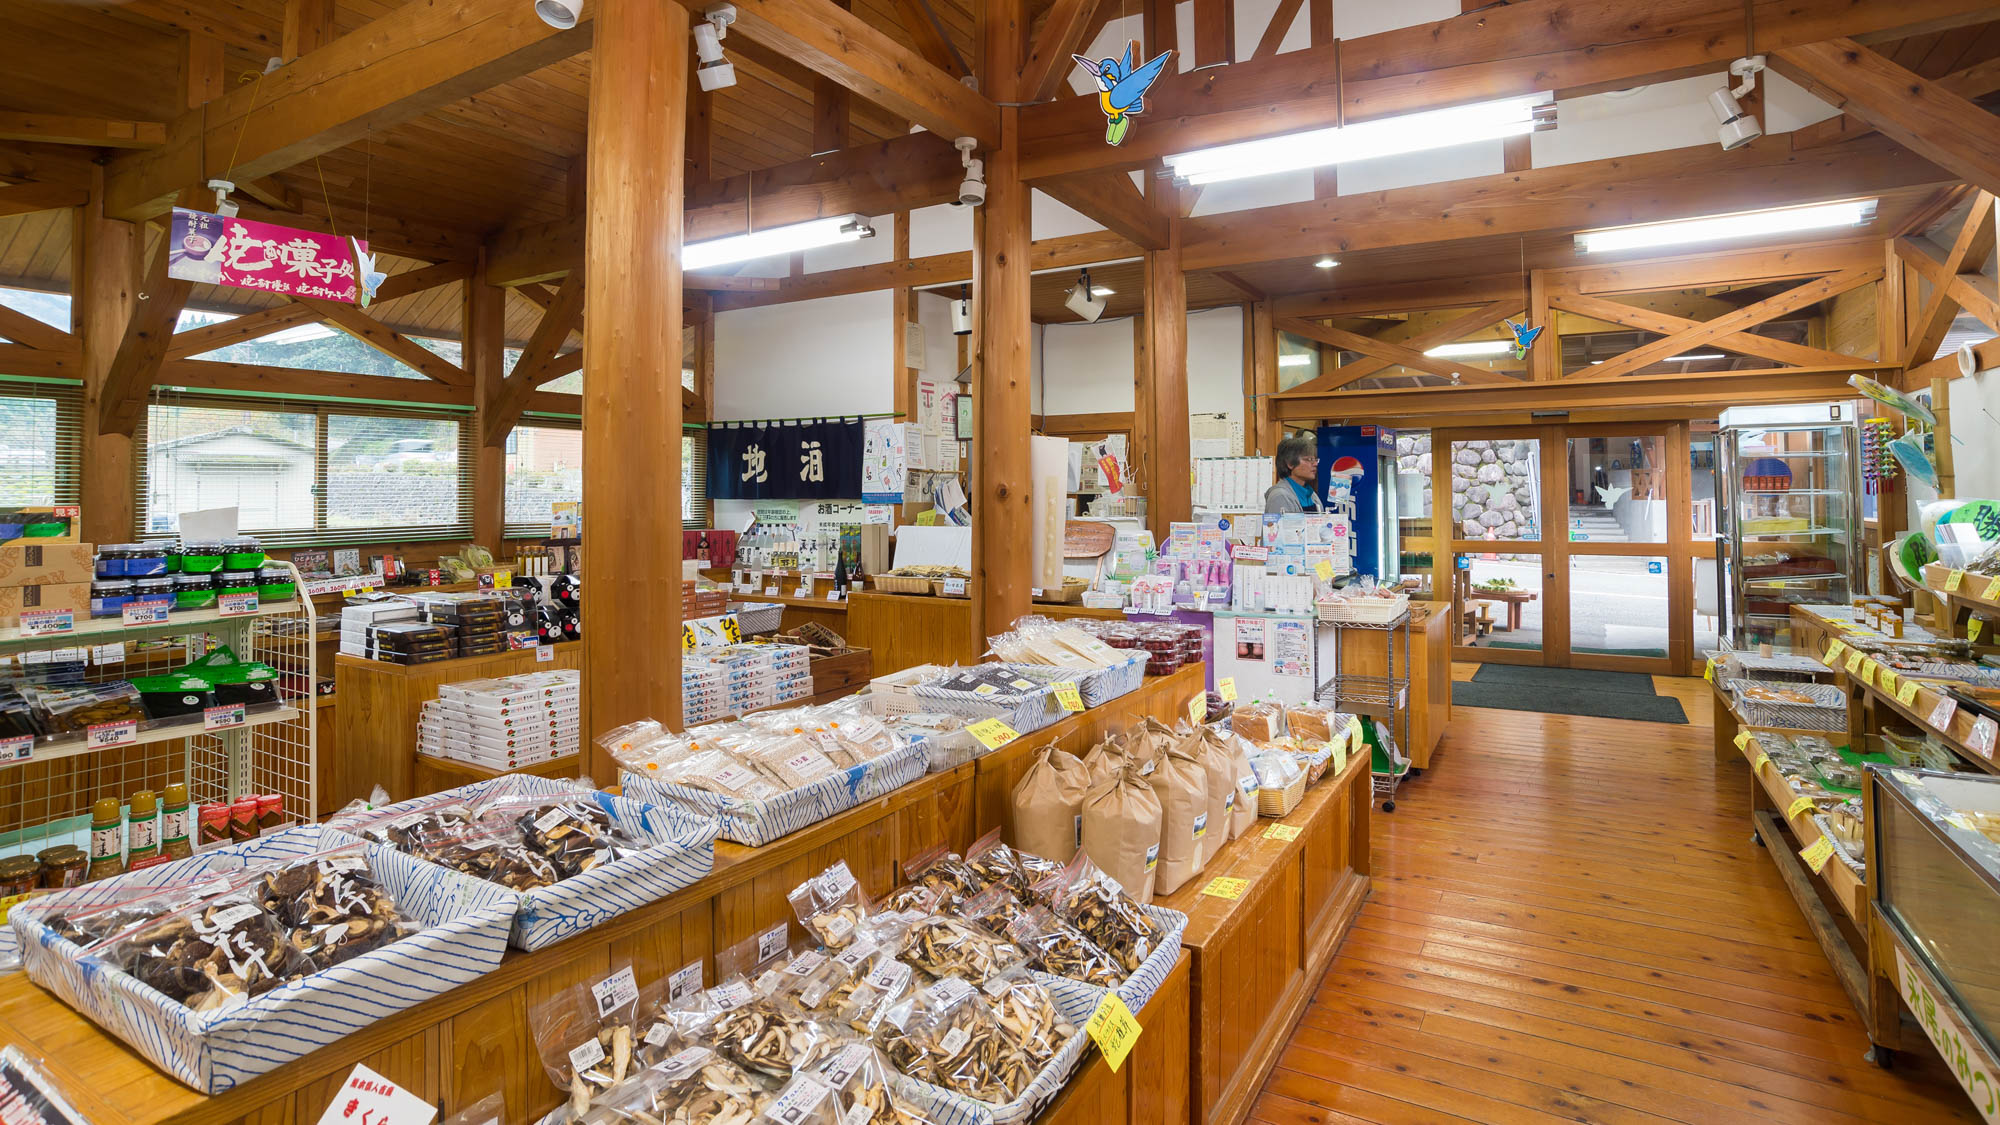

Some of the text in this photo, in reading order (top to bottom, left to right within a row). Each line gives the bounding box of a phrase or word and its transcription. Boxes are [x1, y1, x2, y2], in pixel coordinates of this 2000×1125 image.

[55, 508, 79, 517] 見本
[817, 503, 862, 514] お酒コーナー
